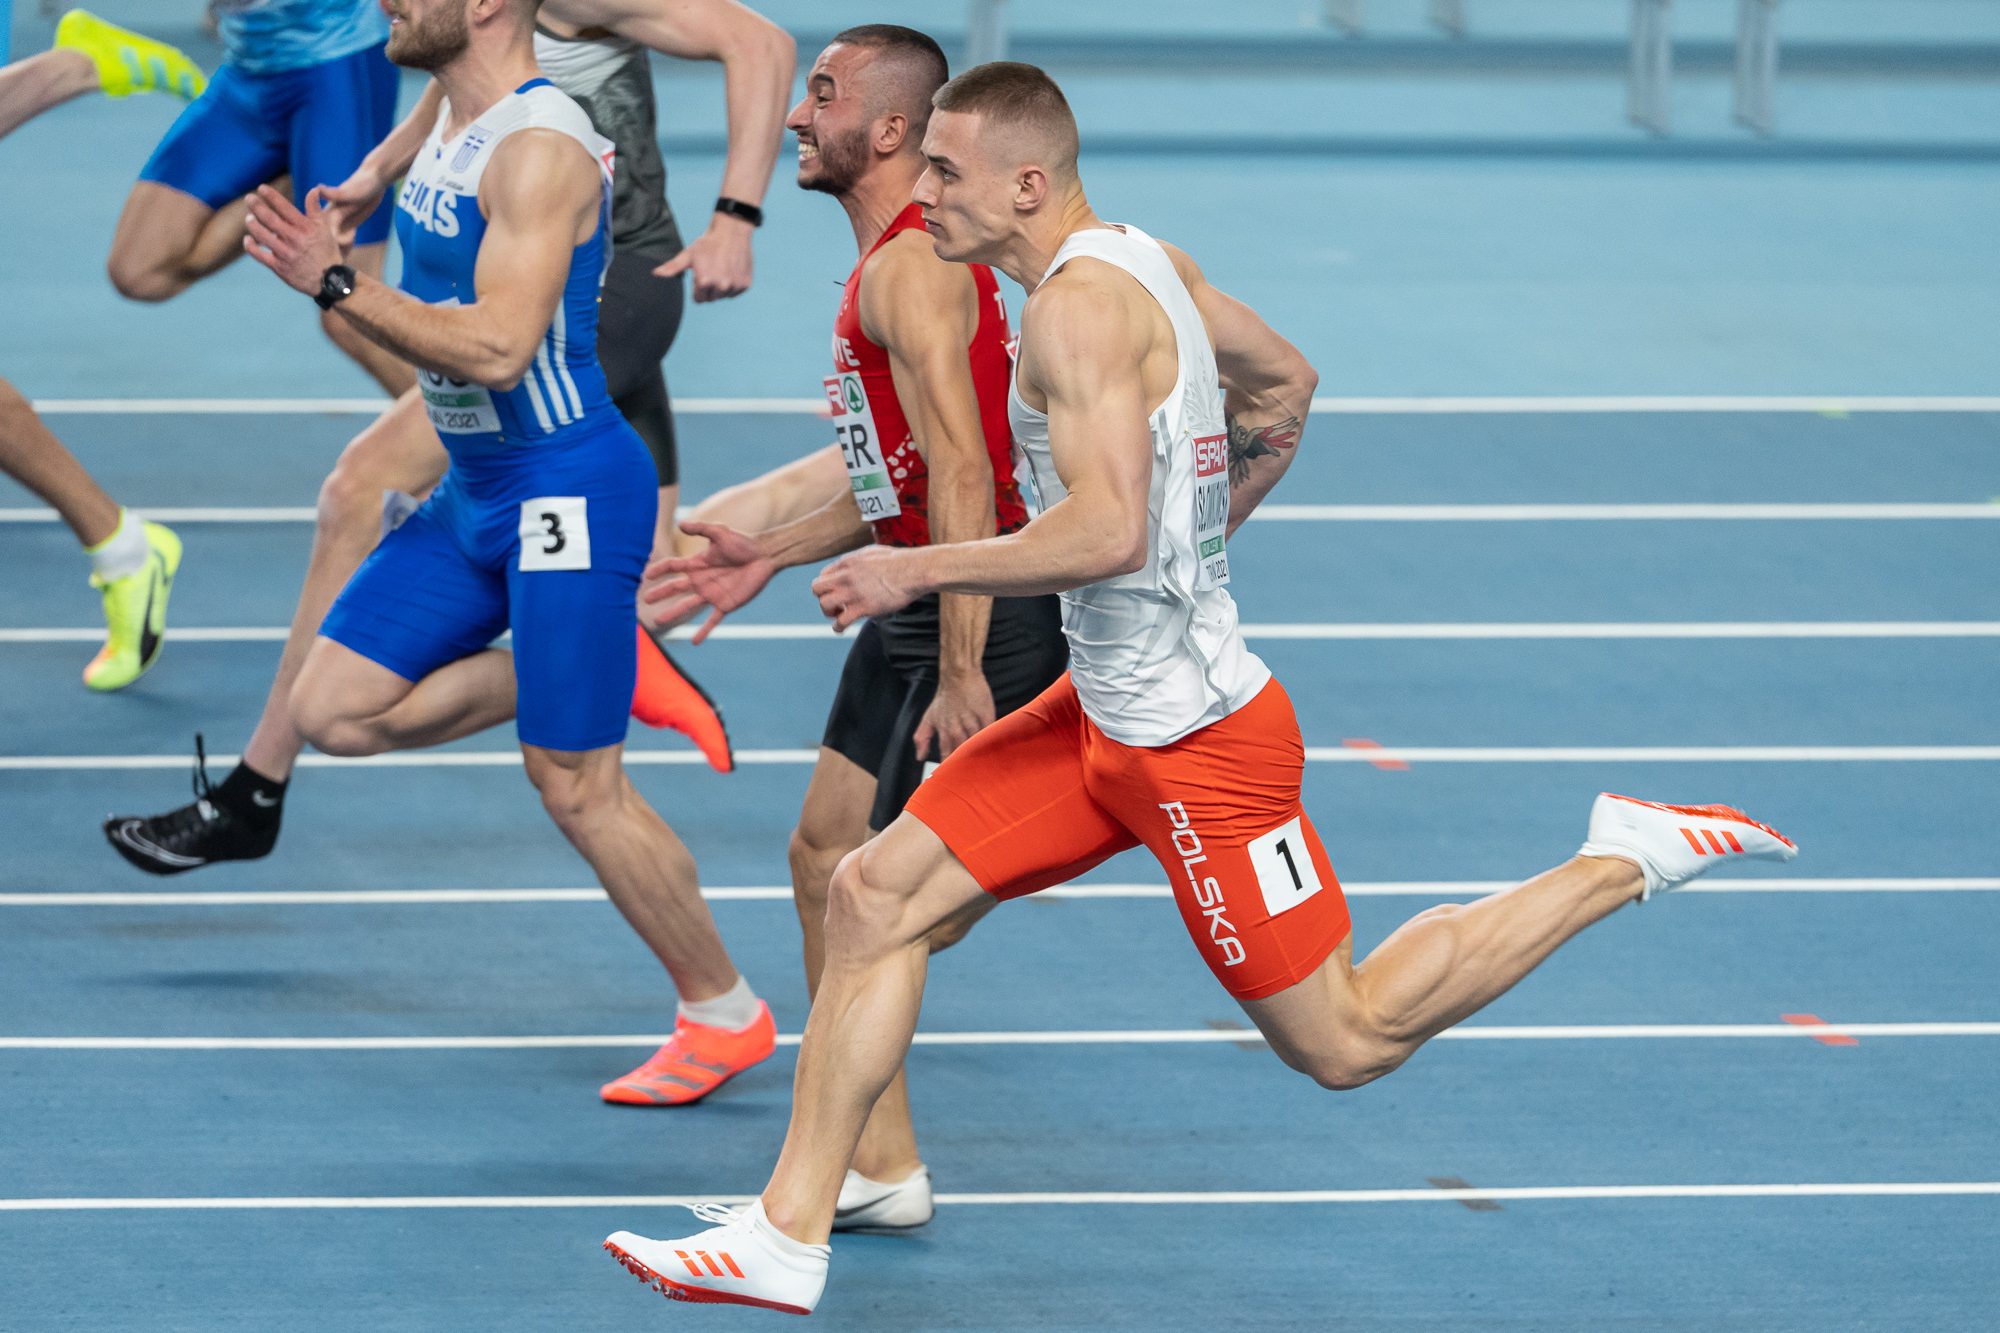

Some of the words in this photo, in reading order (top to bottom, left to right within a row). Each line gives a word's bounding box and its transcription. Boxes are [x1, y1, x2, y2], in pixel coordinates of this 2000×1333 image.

[445, 412, 480, 428] 2021
[836, 424, 876, 469] ER
[1197, 438, 1228, 471] SPAR
[858, 494, 884, 514] 021
[541, 511, 566, 554] 3
[1215, 559, 1229, 579] 2021
[1275, 838, 1303, 891] 1
[1159, 801, 1246, 967] POLSKA
